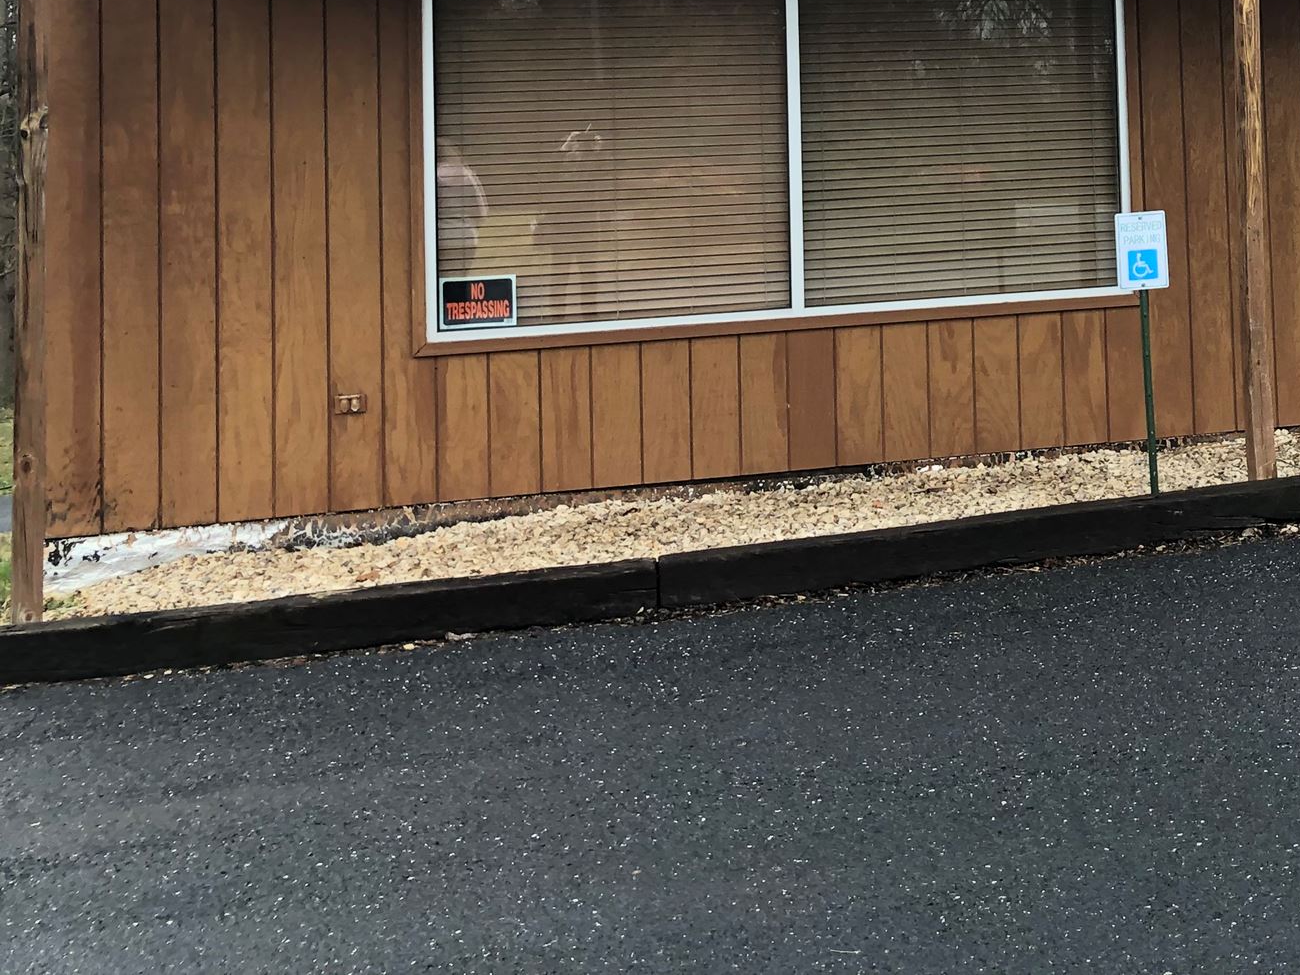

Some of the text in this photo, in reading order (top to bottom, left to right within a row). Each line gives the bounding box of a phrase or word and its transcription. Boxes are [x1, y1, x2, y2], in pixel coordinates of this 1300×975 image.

[1120, 220, 1162, 232] RESERVED
[1123, 233, 1161, 245] PARKING
[471, 282, 485, 300] NO
[446, 299, 510, 320] TRESPASSING
